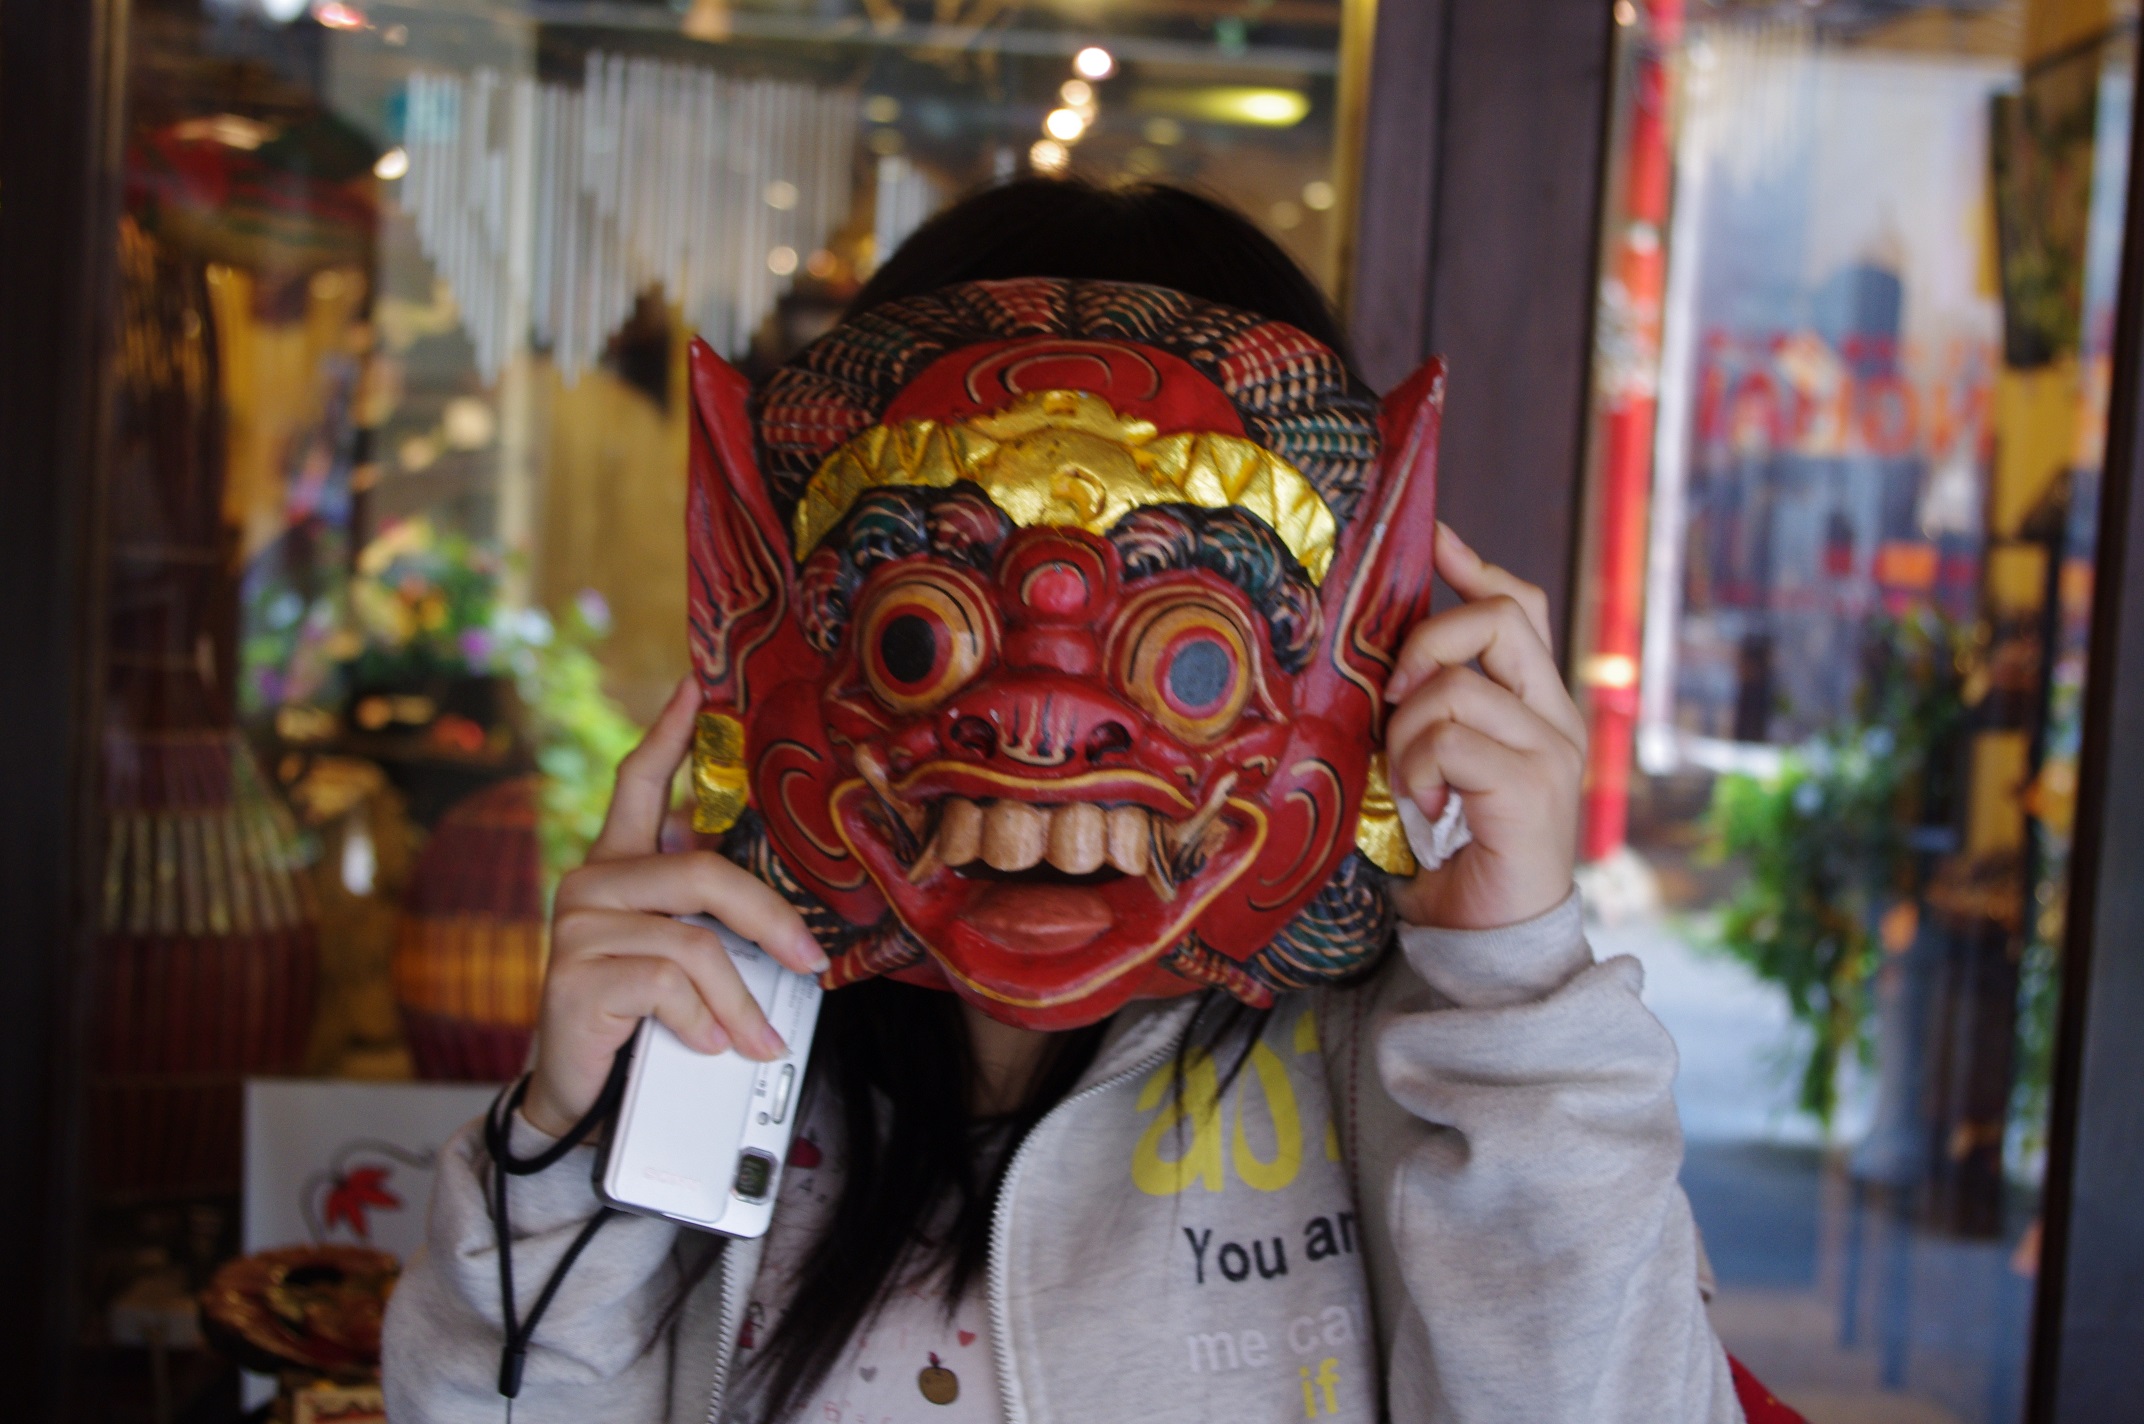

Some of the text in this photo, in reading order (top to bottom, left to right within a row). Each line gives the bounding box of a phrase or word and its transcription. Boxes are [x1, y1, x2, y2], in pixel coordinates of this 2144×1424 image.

[1182, 1226, 1288, 1284] You
[1187, 1329, 1270, 1374] me
[1299, 1356, 1342, 1419] if
